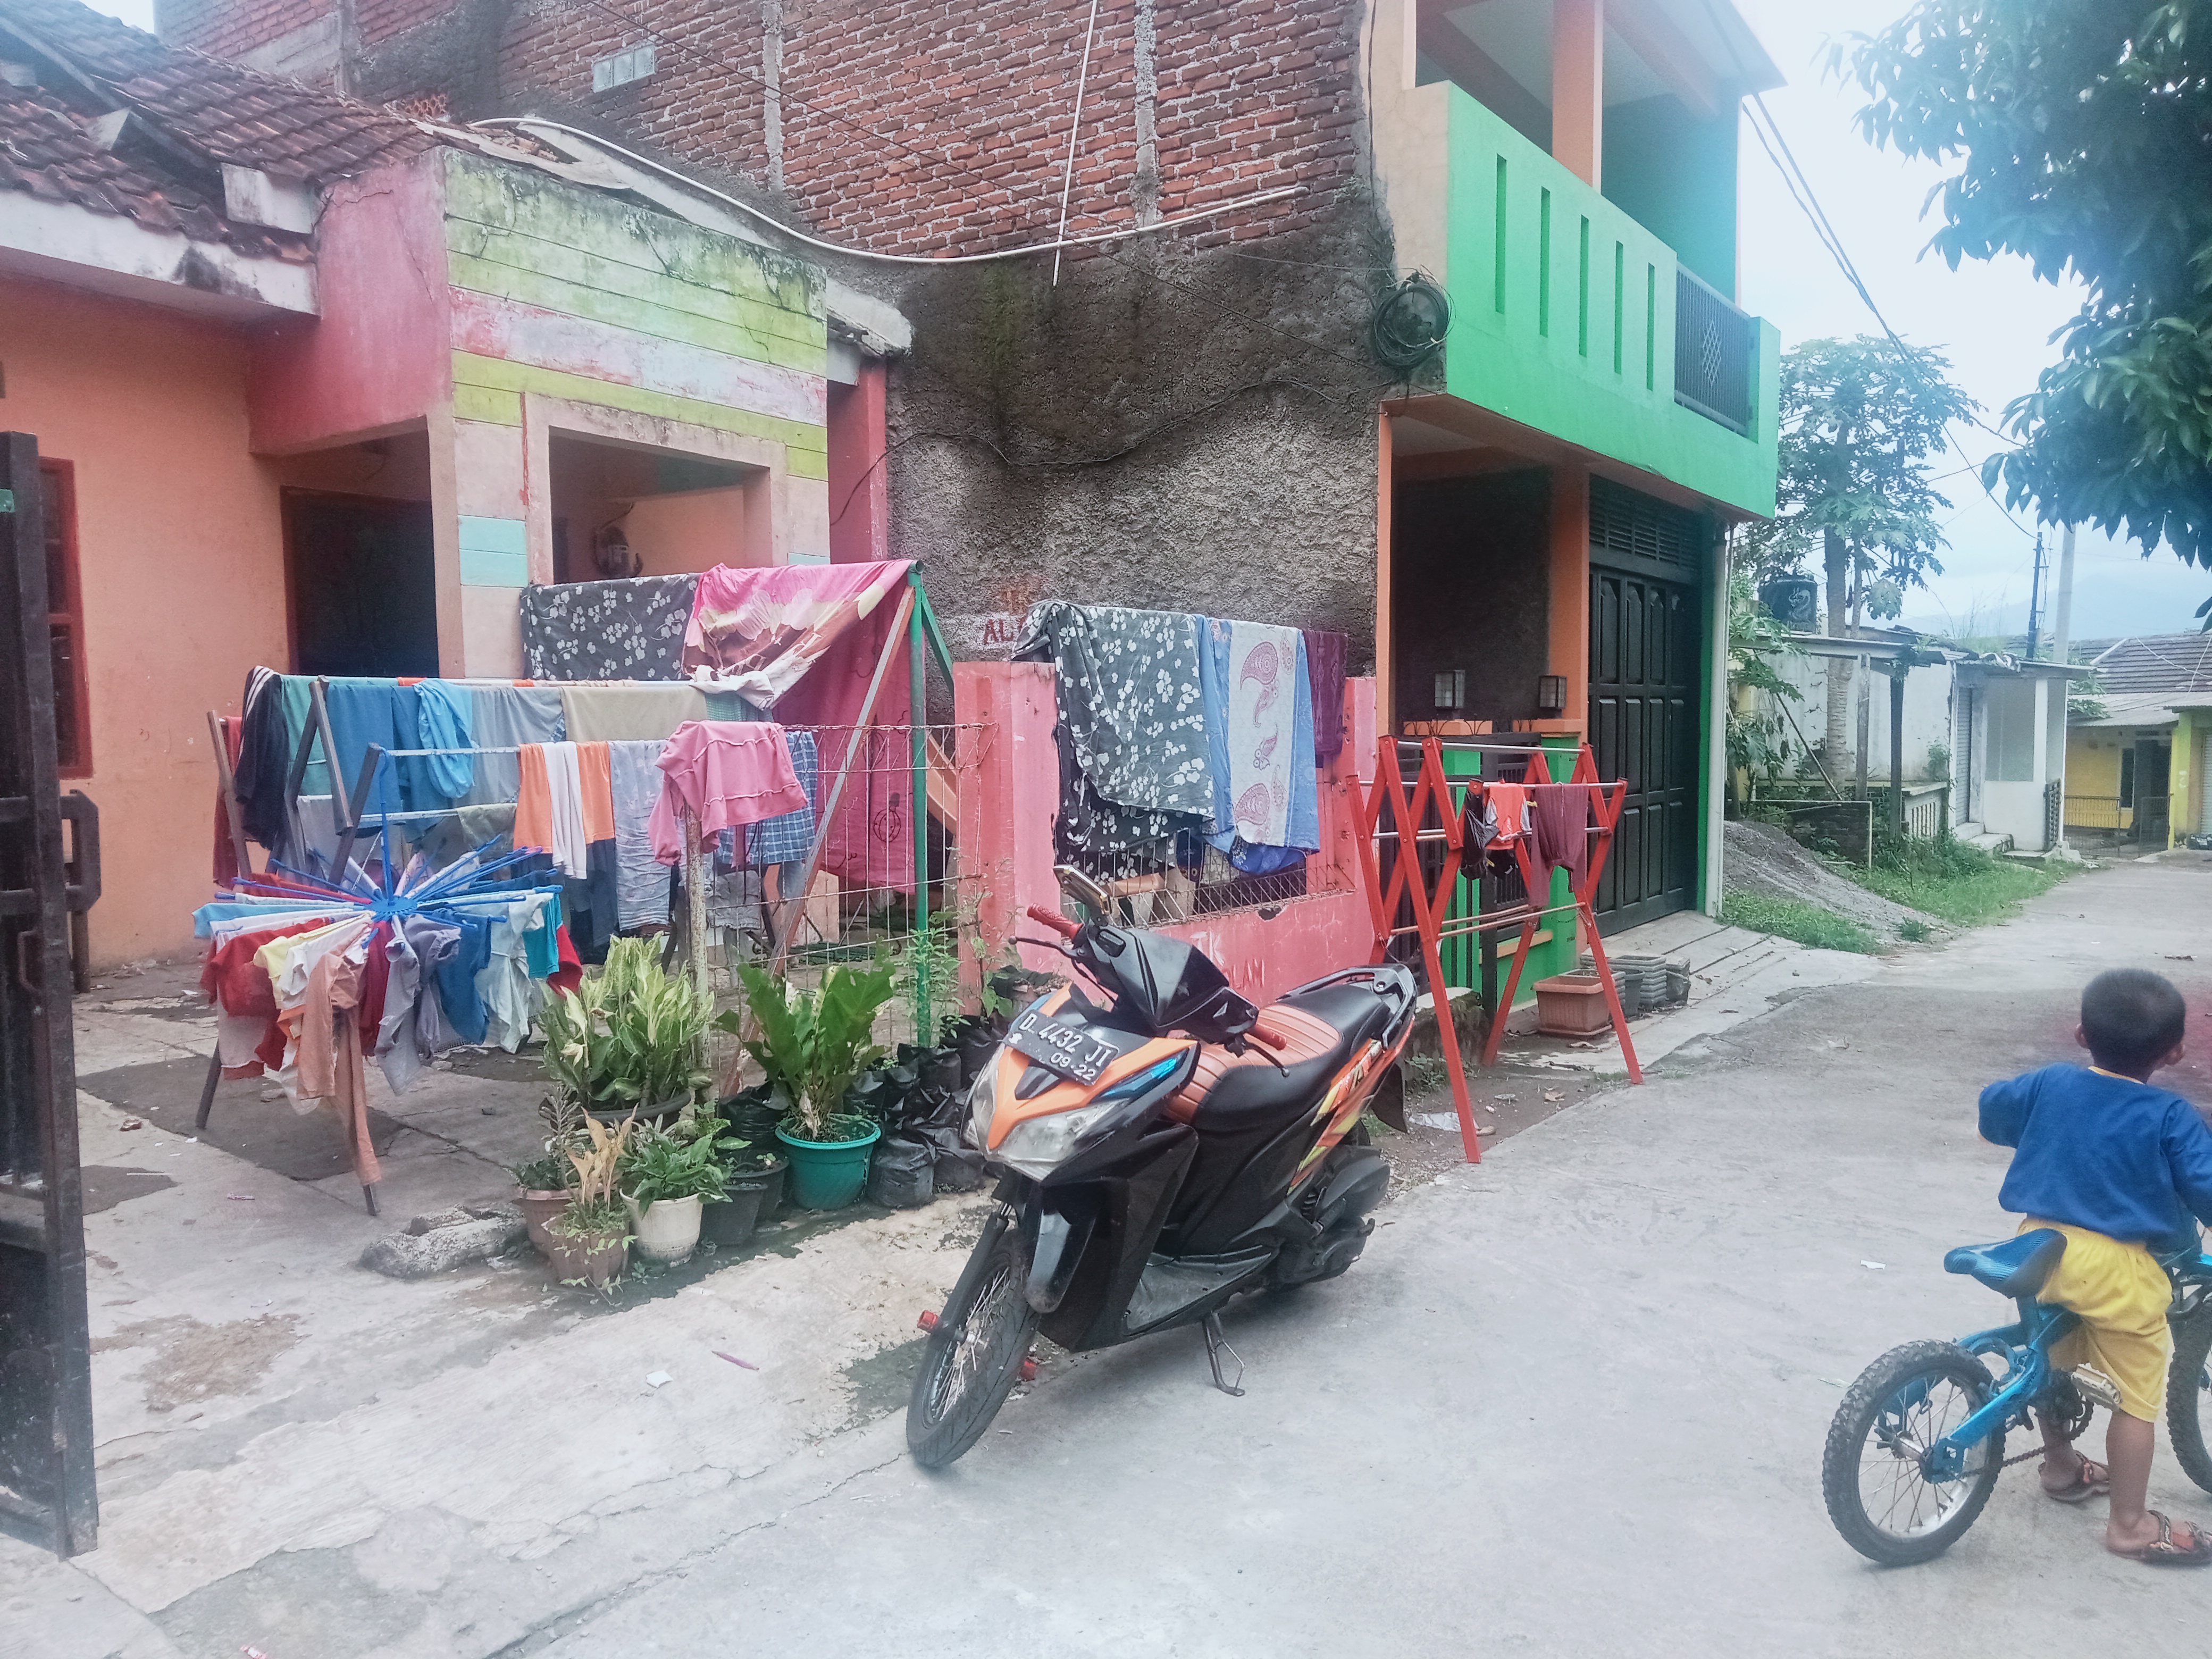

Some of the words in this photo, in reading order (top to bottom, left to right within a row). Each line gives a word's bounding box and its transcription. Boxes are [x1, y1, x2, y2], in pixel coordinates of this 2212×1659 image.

[1019, 1012, 1037, 1030] D
[1038, 1023, 1083, 1053] 4432
[1085, 1045, 1111, 1067] JI
